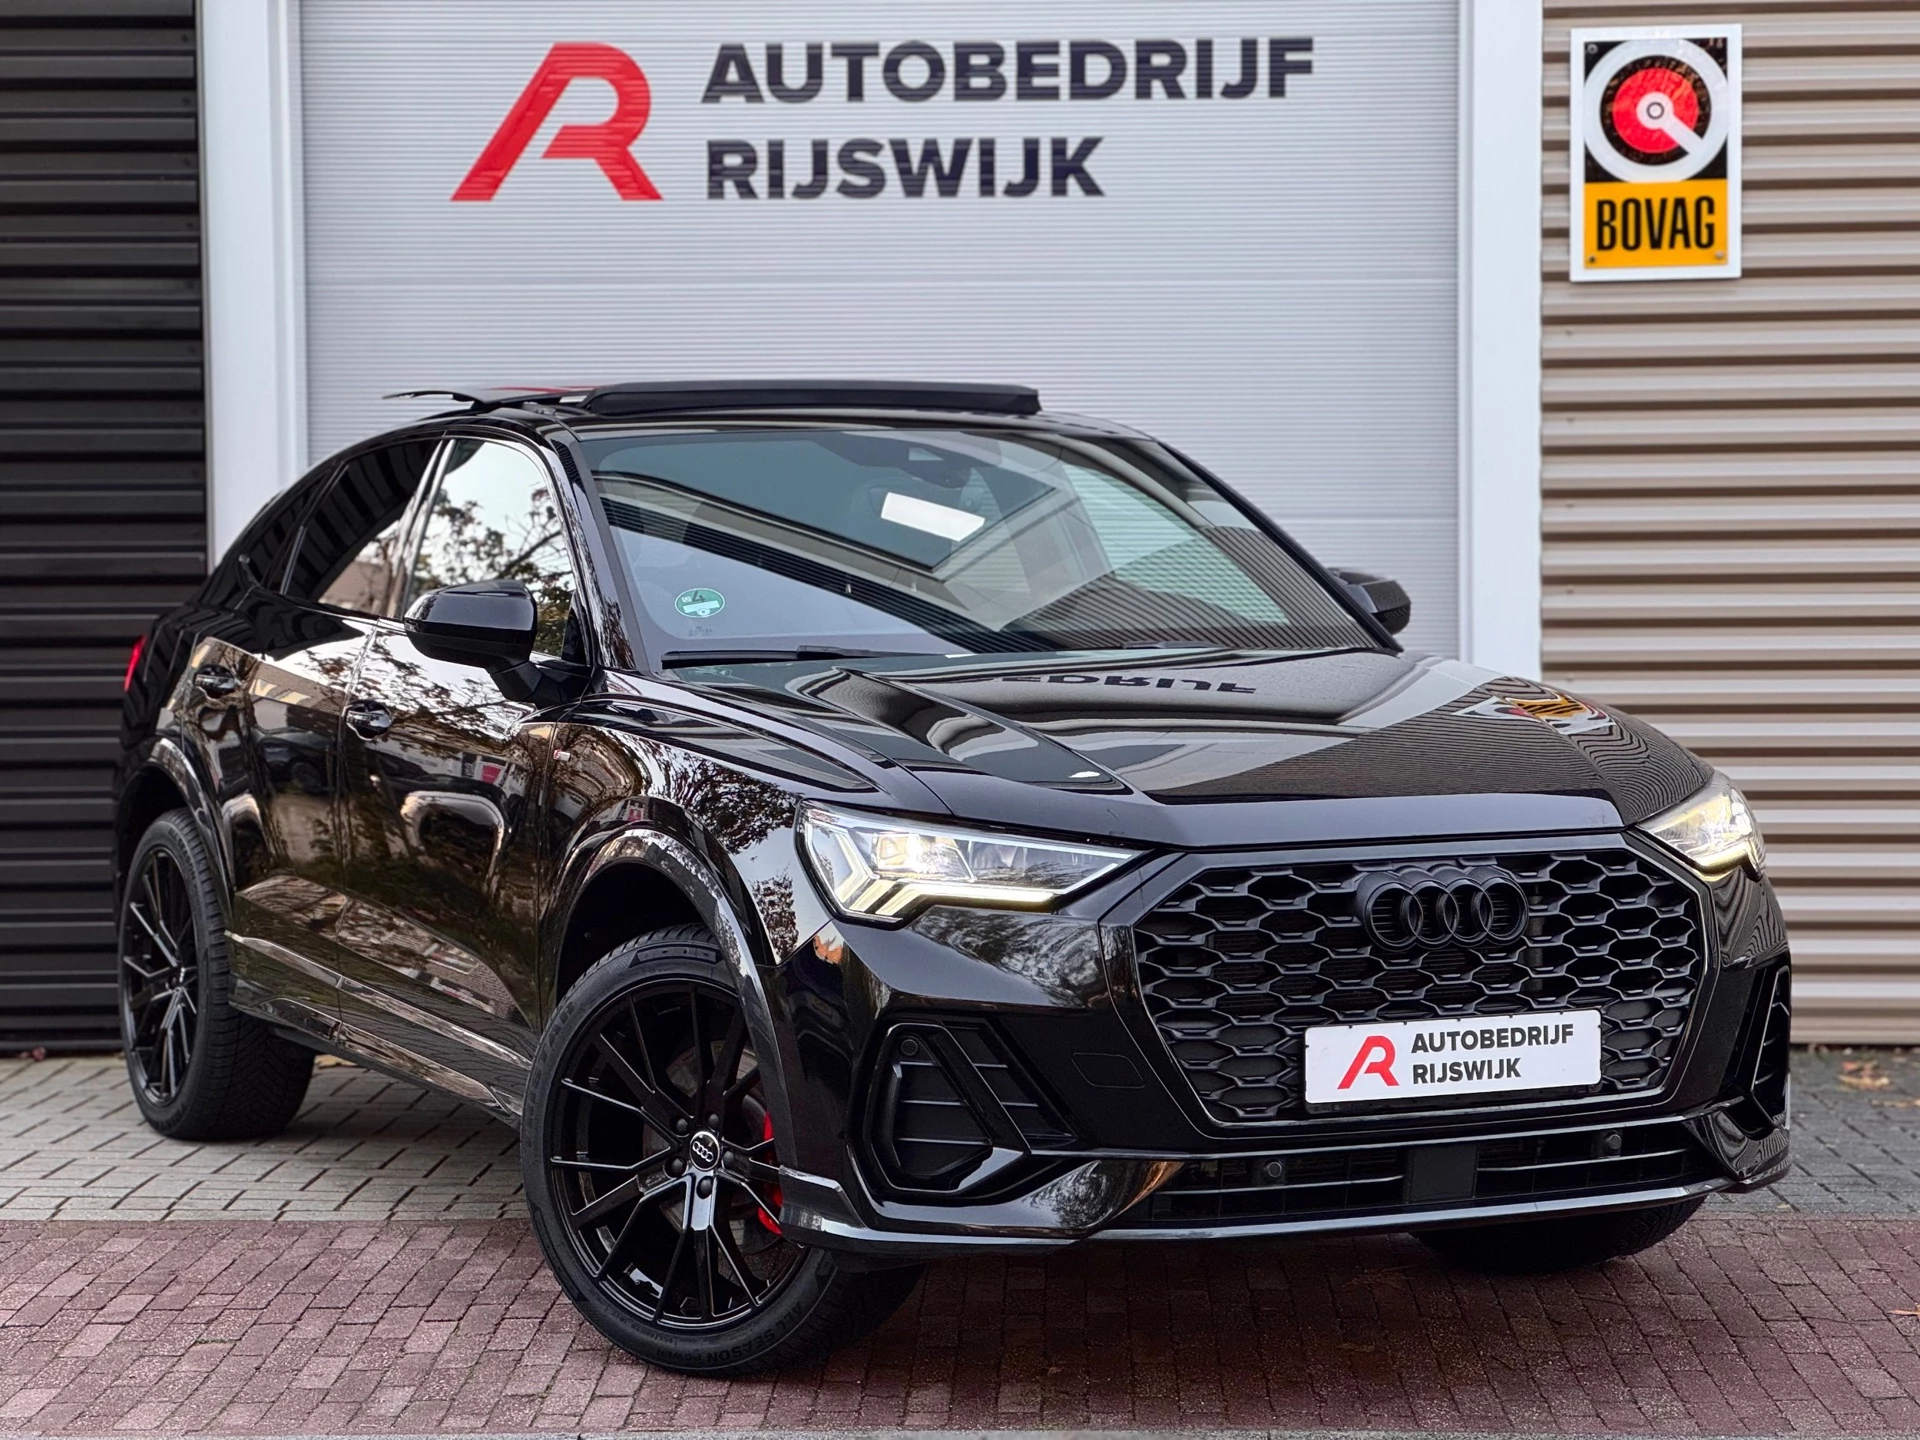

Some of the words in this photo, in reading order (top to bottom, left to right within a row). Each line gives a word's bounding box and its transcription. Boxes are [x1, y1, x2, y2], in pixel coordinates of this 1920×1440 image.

[702, 37, 1313, 103] AUTOBEDRIJF
[707, 137, 1105, 200] RIJSWIJK
[1597, 195, 1715, 251] BOVAG
[1411, 1023, 1574, 1054] AUTOBEDRIJF
[1412, 1057, 1521, 1085] RIJSWIJK
[706, 1328, 775, 1363] SEASON
